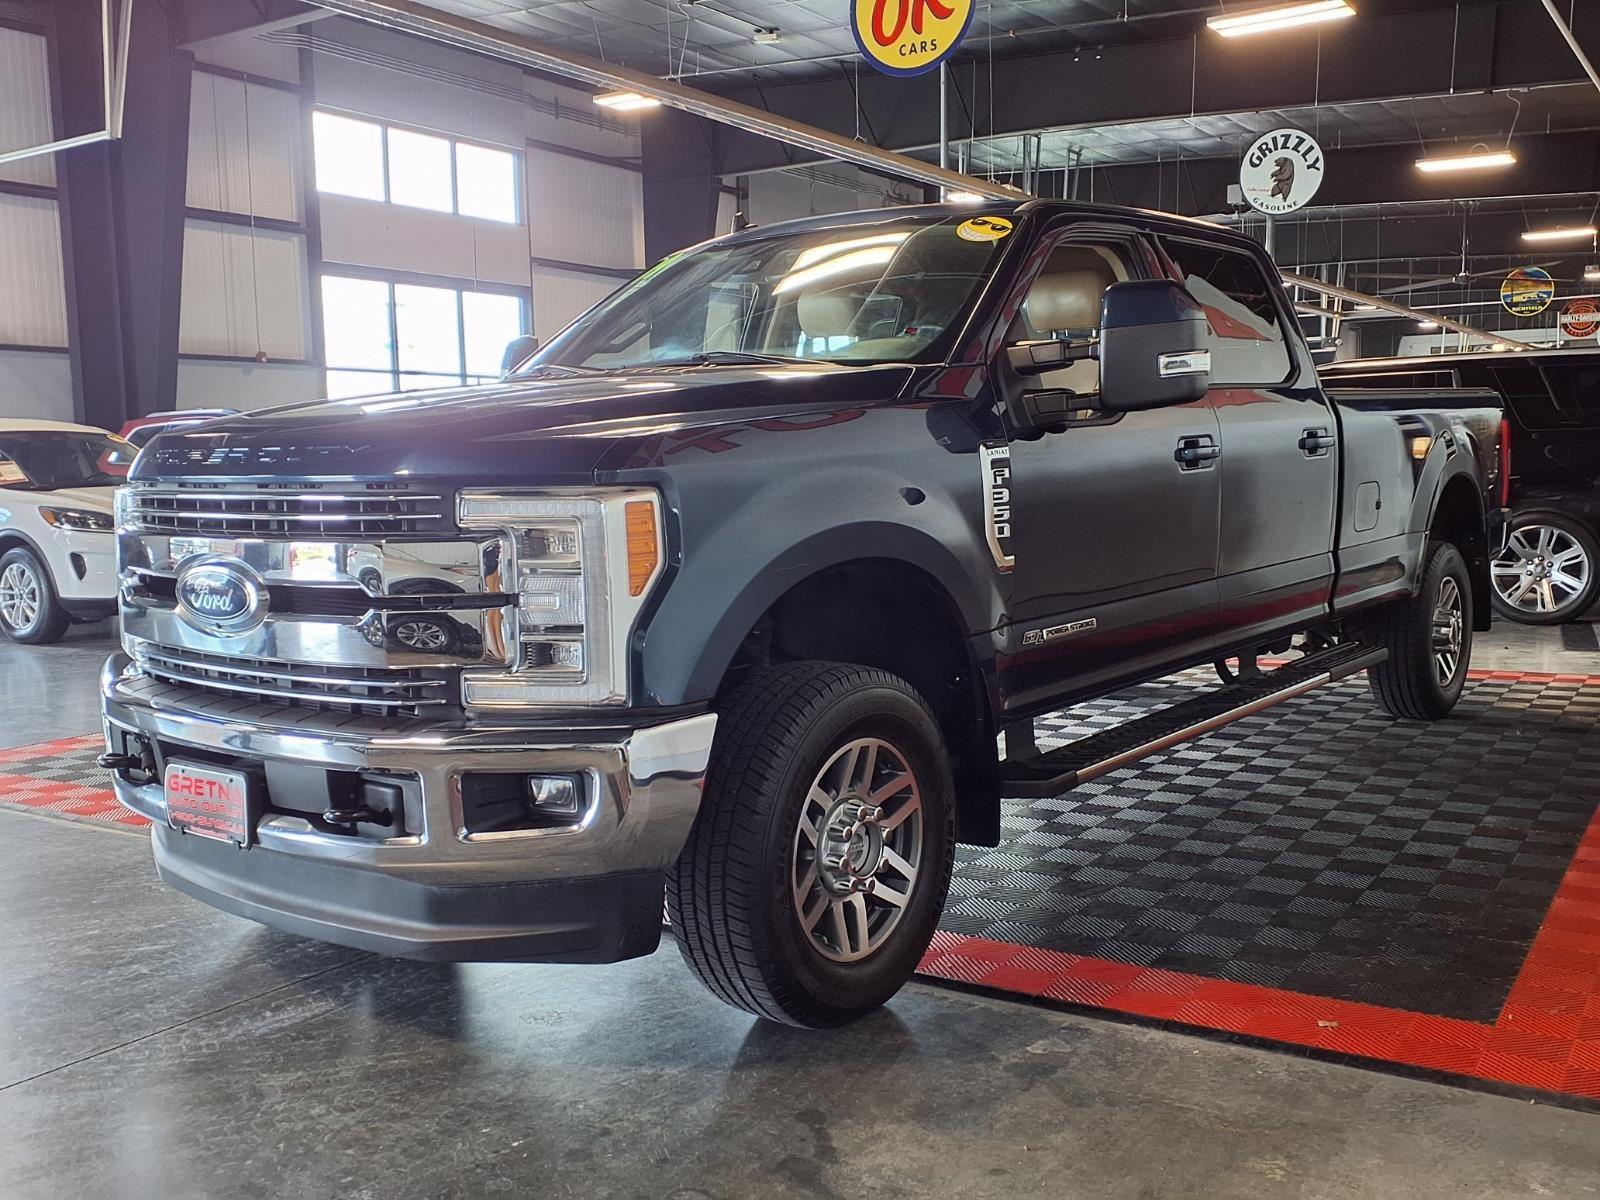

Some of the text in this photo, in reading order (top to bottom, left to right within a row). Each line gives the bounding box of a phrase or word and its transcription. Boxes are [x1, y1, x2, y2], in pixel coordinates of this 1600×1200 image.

[899, 39, 937, 56] CARS
[1249, 133, 1320, 172] GRIZZLY
[1253, 197, 1299, 211] GASOLINE
[987, 448, 1008, 458] LARIAT
[187, 579, 233, 611] Ford
[1046, 625, 1070, 637] POWER
[1070, 619, 1095, 631] STROKE
[168, 774, 243, 804] GRETN
